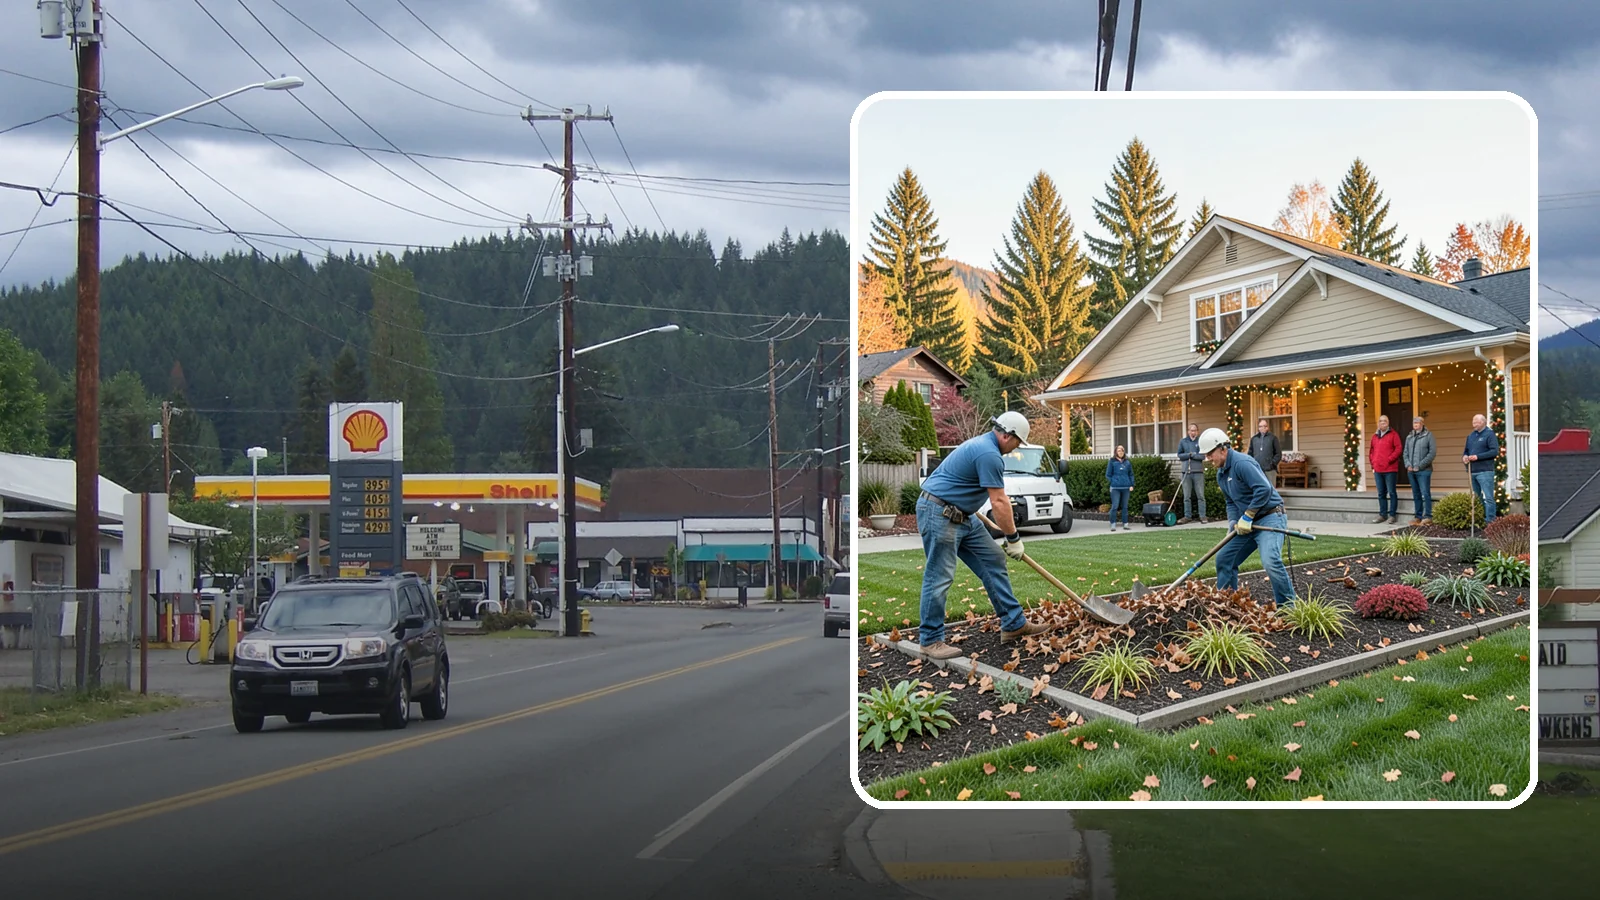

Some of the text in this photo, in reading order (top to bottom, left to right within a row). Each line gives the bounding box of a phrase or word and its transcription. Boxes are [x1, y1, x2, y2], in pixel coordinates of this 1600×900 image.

[365, 480, 383, 490] 395
[490, 484, 547, 499] Shell
[365, 494, 383, 504] 405
[365, 508, 383, 518] 415
[365, 522, 383, 532] 429
